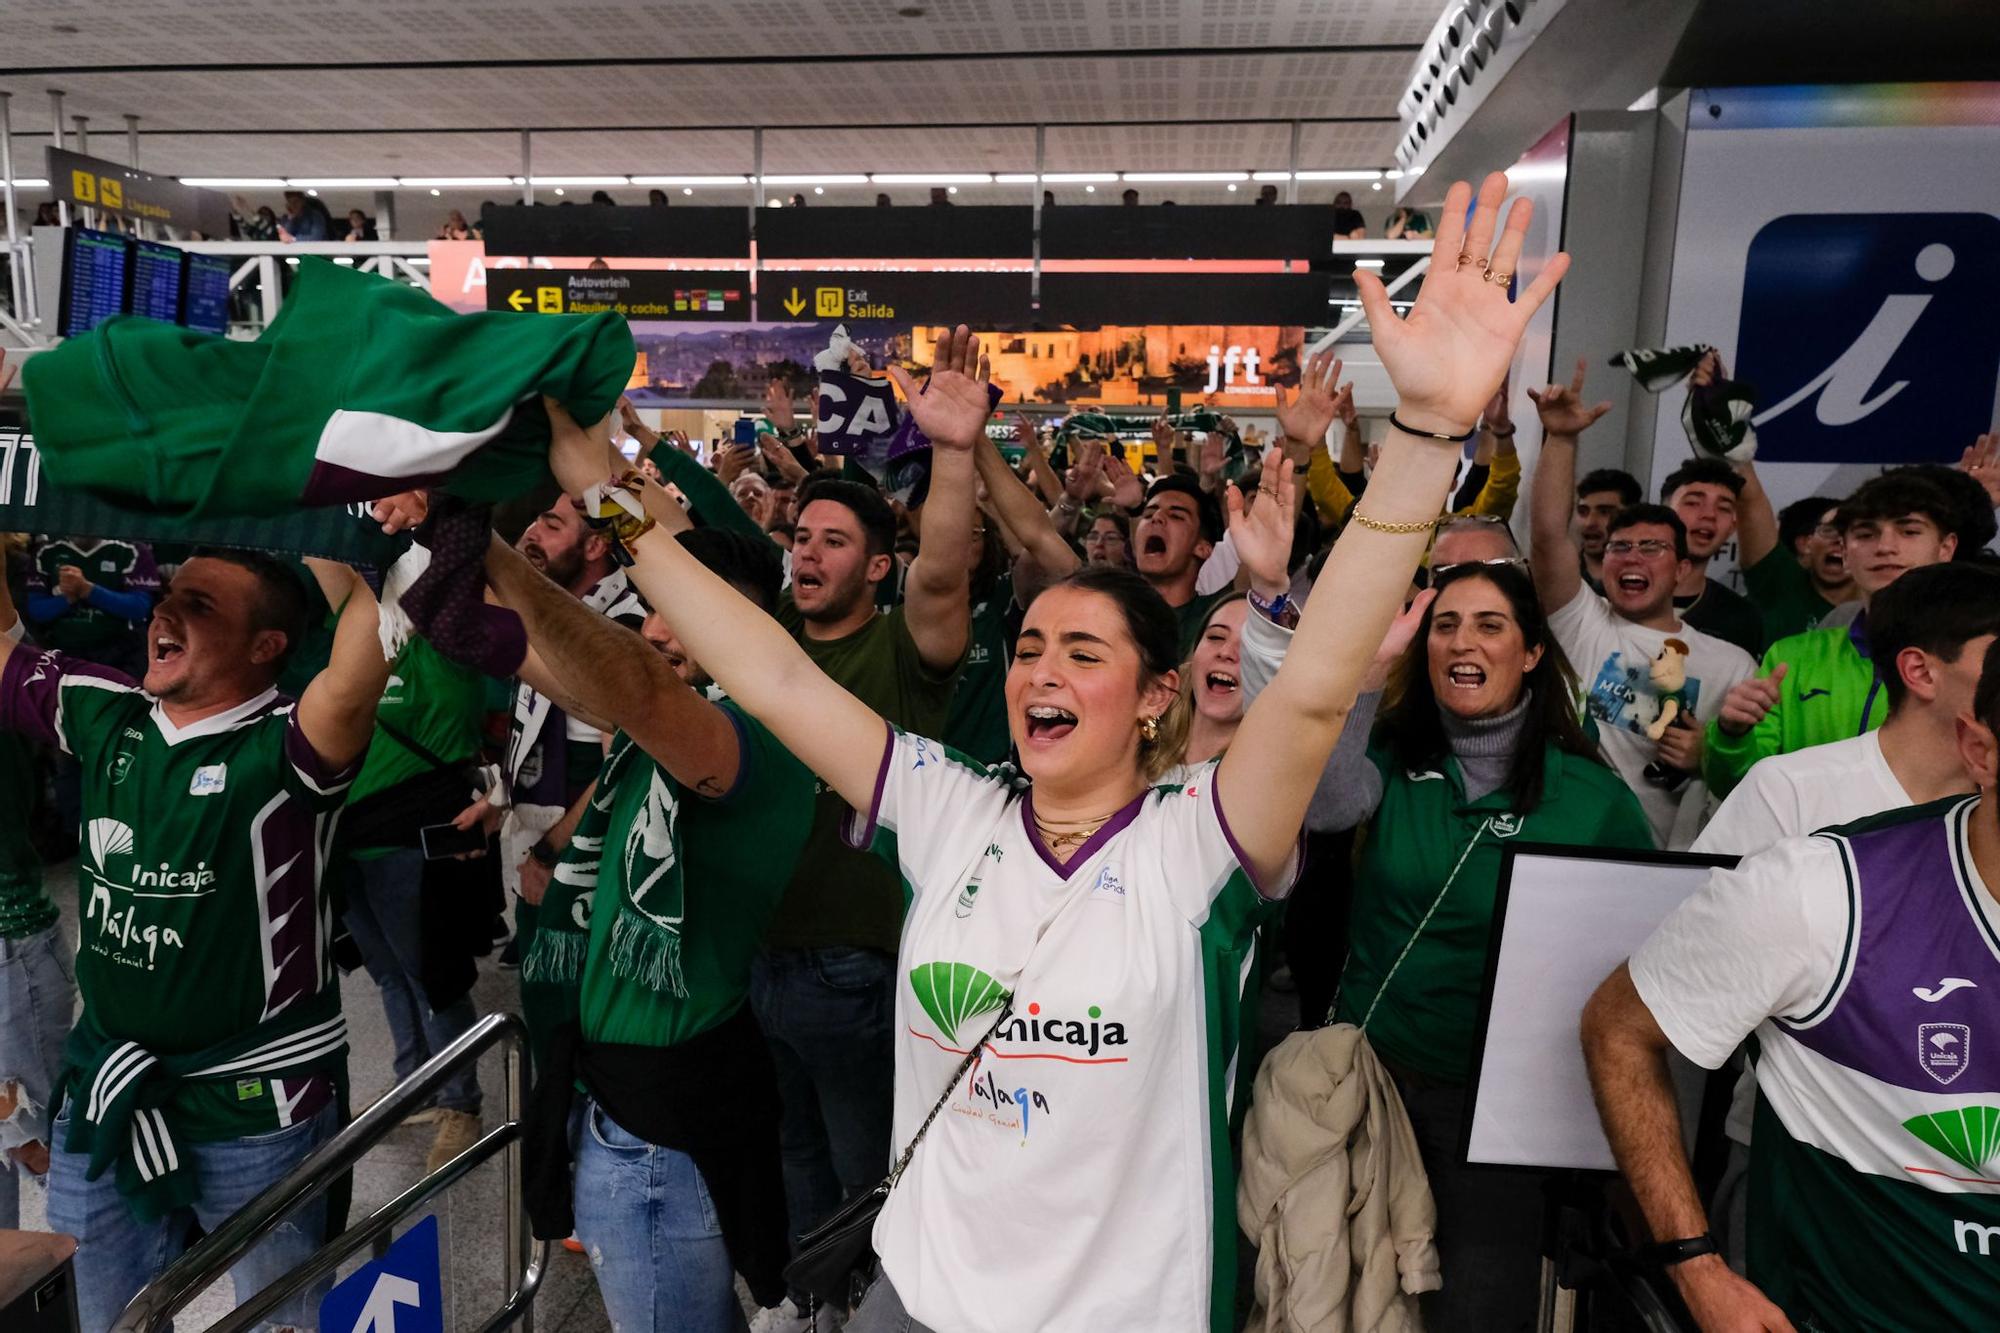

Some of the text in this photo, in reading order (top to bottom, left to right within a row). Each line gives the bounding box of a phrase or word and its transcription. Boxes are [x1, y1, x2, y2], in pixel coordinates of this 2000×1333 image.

[568, 275, 630, 288] Autoverleih
[568, 289, 618, 300] Car Rental
[848, 289, 868, 302] Exit
[615, 302, 628, 314] de
[631, 302, 669, 314] coches
[848, 303, 895, 318] Salida
[1203, 345, 1261, 394] jft
